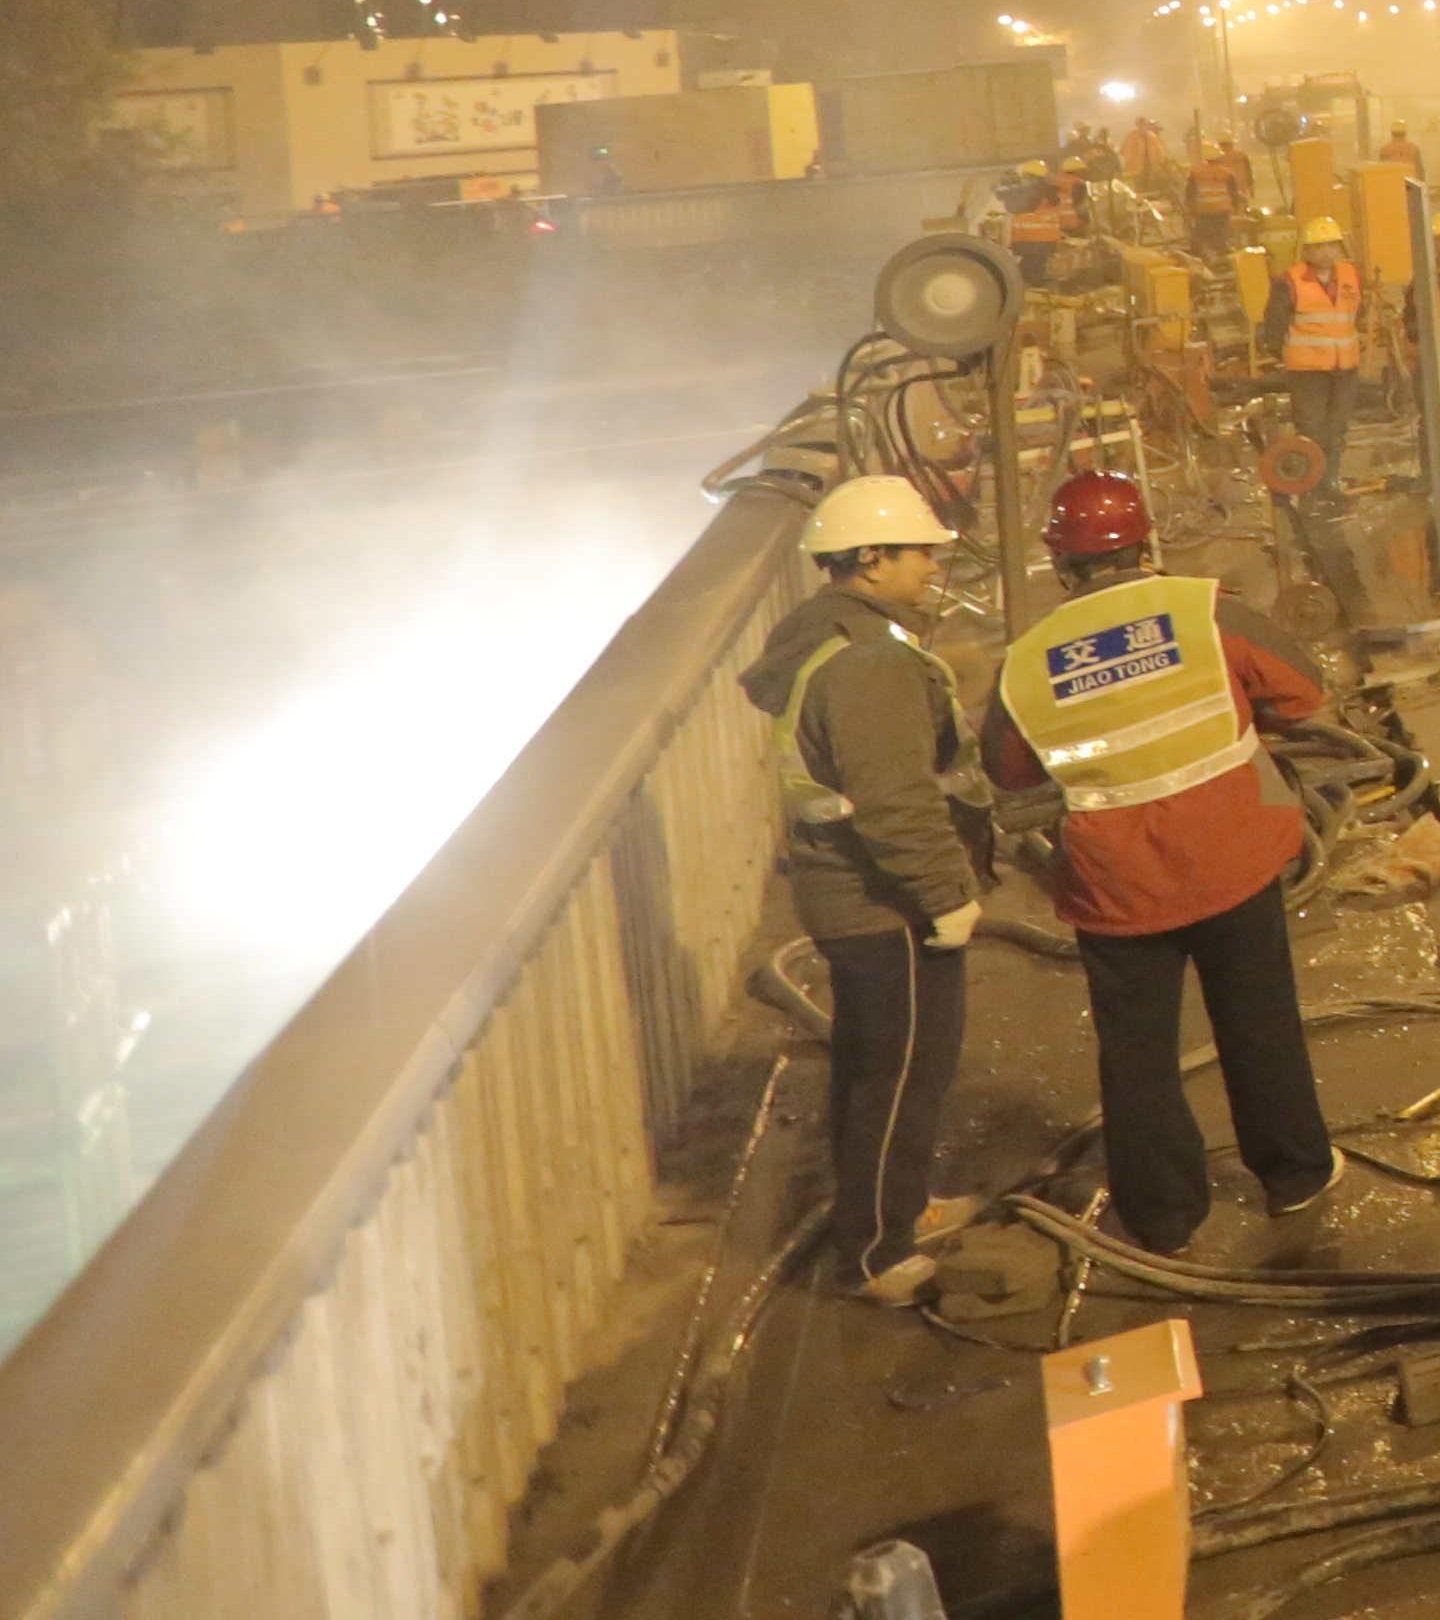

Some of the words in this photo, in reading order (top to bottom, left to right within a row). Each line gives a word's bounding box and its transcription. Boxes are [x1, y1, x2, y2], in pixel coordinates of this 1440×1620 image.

[1063, 619, 1164, 670] 交通
[1067, 670, 1112, 695] JIAO
[1115, 652, 1171, 681] TONG
